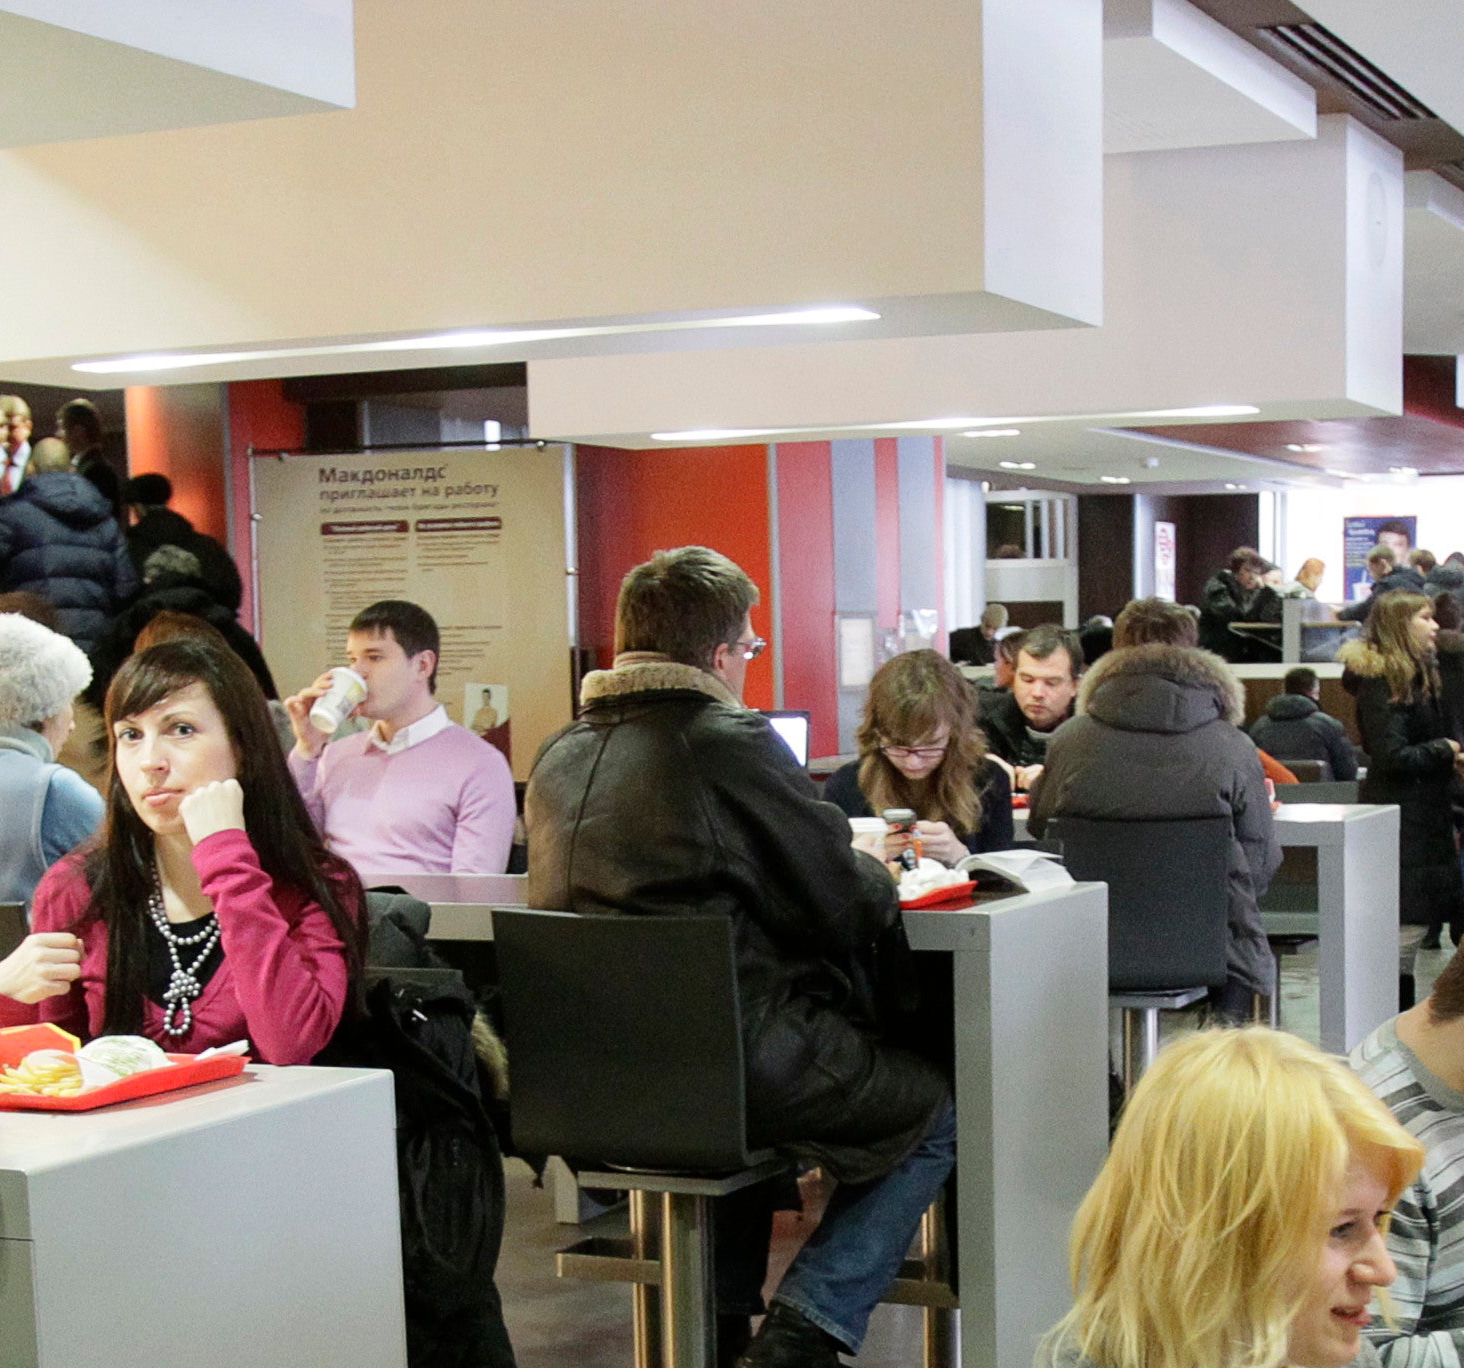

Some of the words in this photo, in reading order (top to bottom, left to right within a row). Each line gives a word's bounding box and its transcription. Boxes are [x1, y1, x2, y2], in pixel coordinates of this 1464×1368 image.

[319, 466, 447, 484] Макдоналдс
[320, 487, 415, 503] приглашает
[422, 486, 439, 497] на
[445, 481, 499, 498] работу
